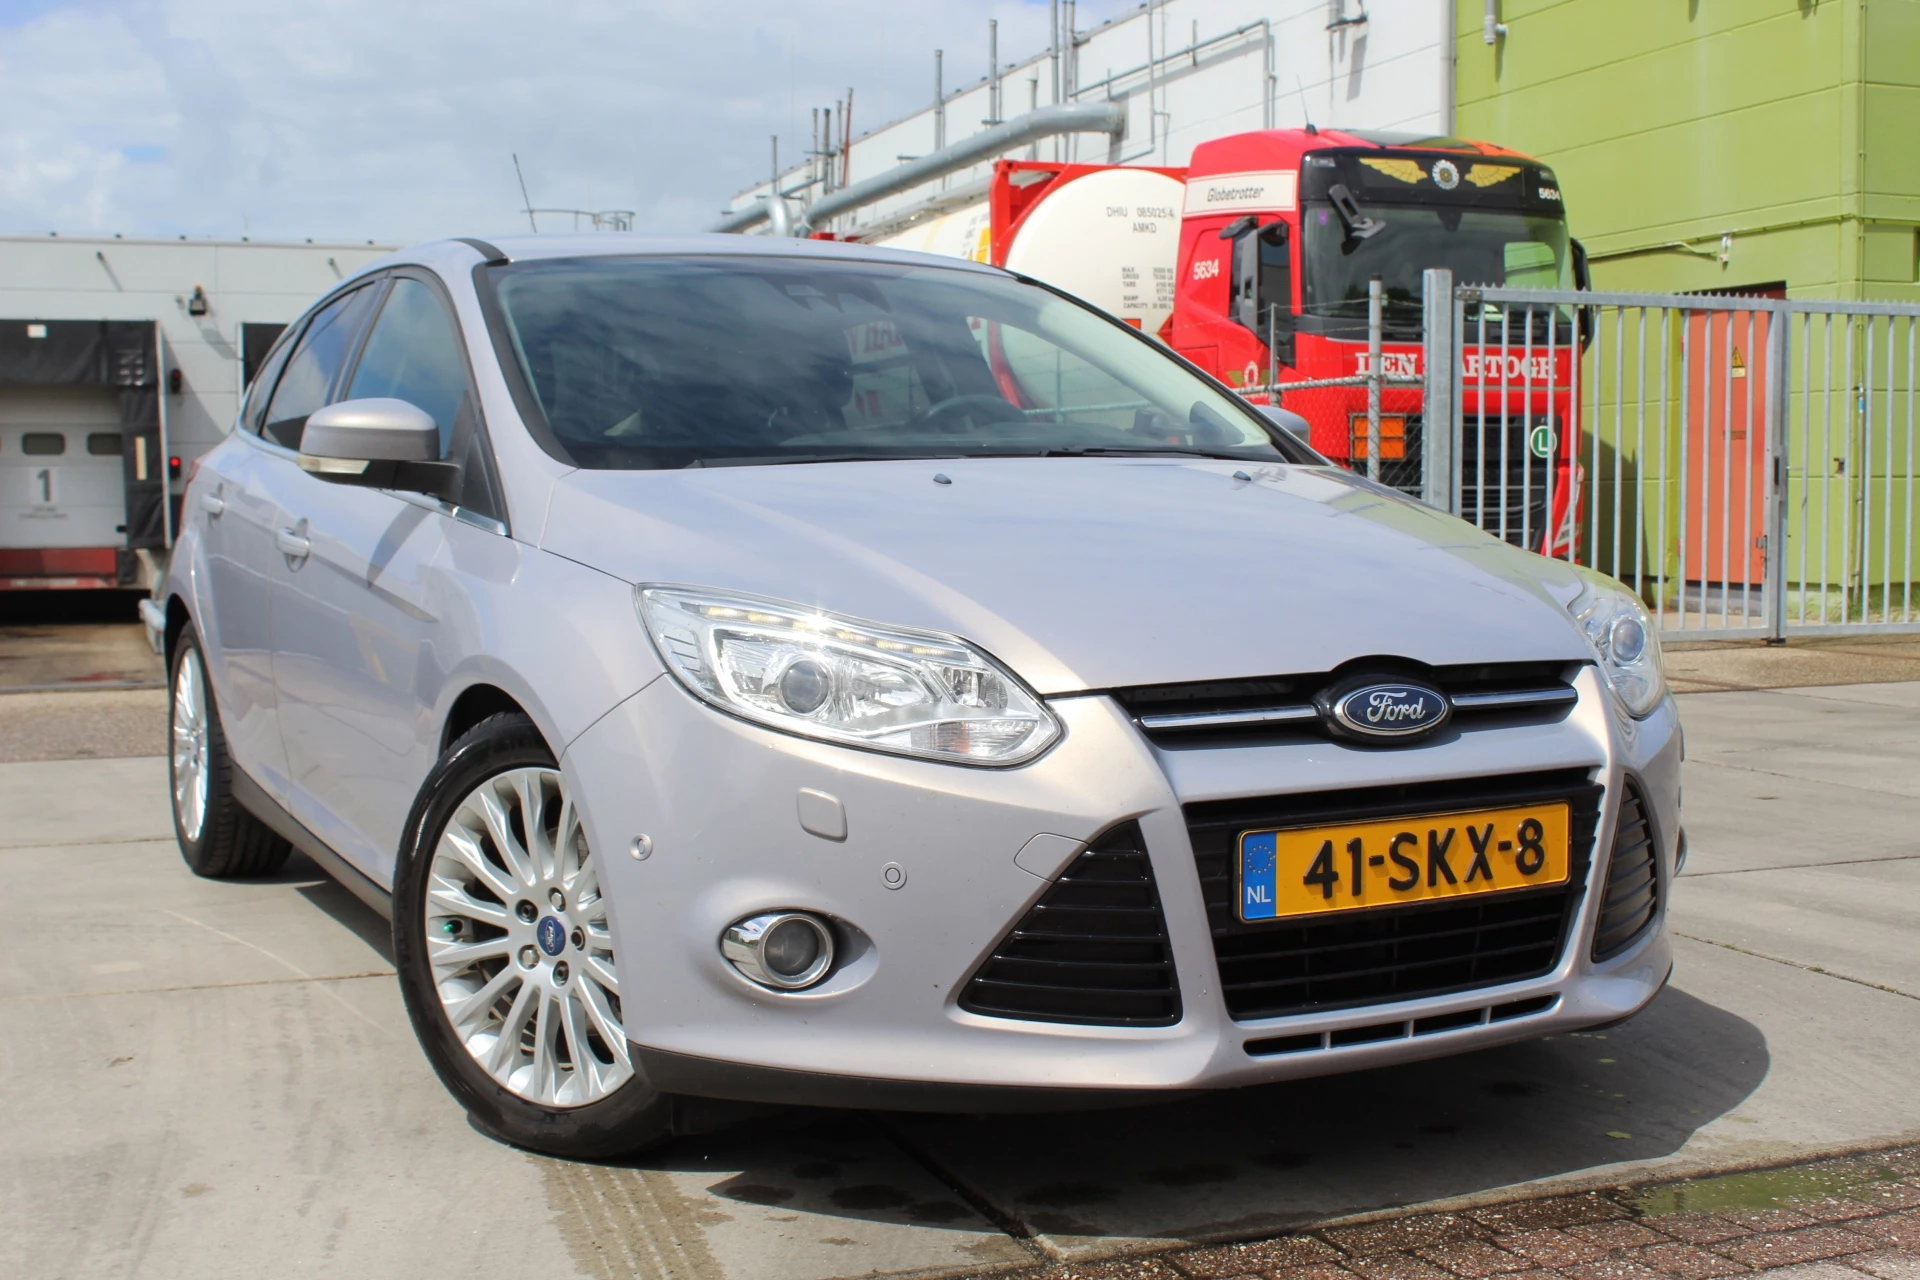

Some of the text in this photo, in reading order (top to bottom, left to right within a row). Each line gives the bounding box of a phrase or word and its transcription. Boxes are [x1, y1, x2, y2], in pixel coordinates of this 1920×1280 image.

[1207, 187, 1264, 202] Globetrotter
[1538, 187, 1560, 201] 5634
[1193, 259, 1220, 280] 5634
[37, 469, 51, 502] 1
[1367, 691, 1426, 722] Ford
[1303, 818, 1545, 899] 41-SKX-8
[1247, 885, 1271, 905] NL
